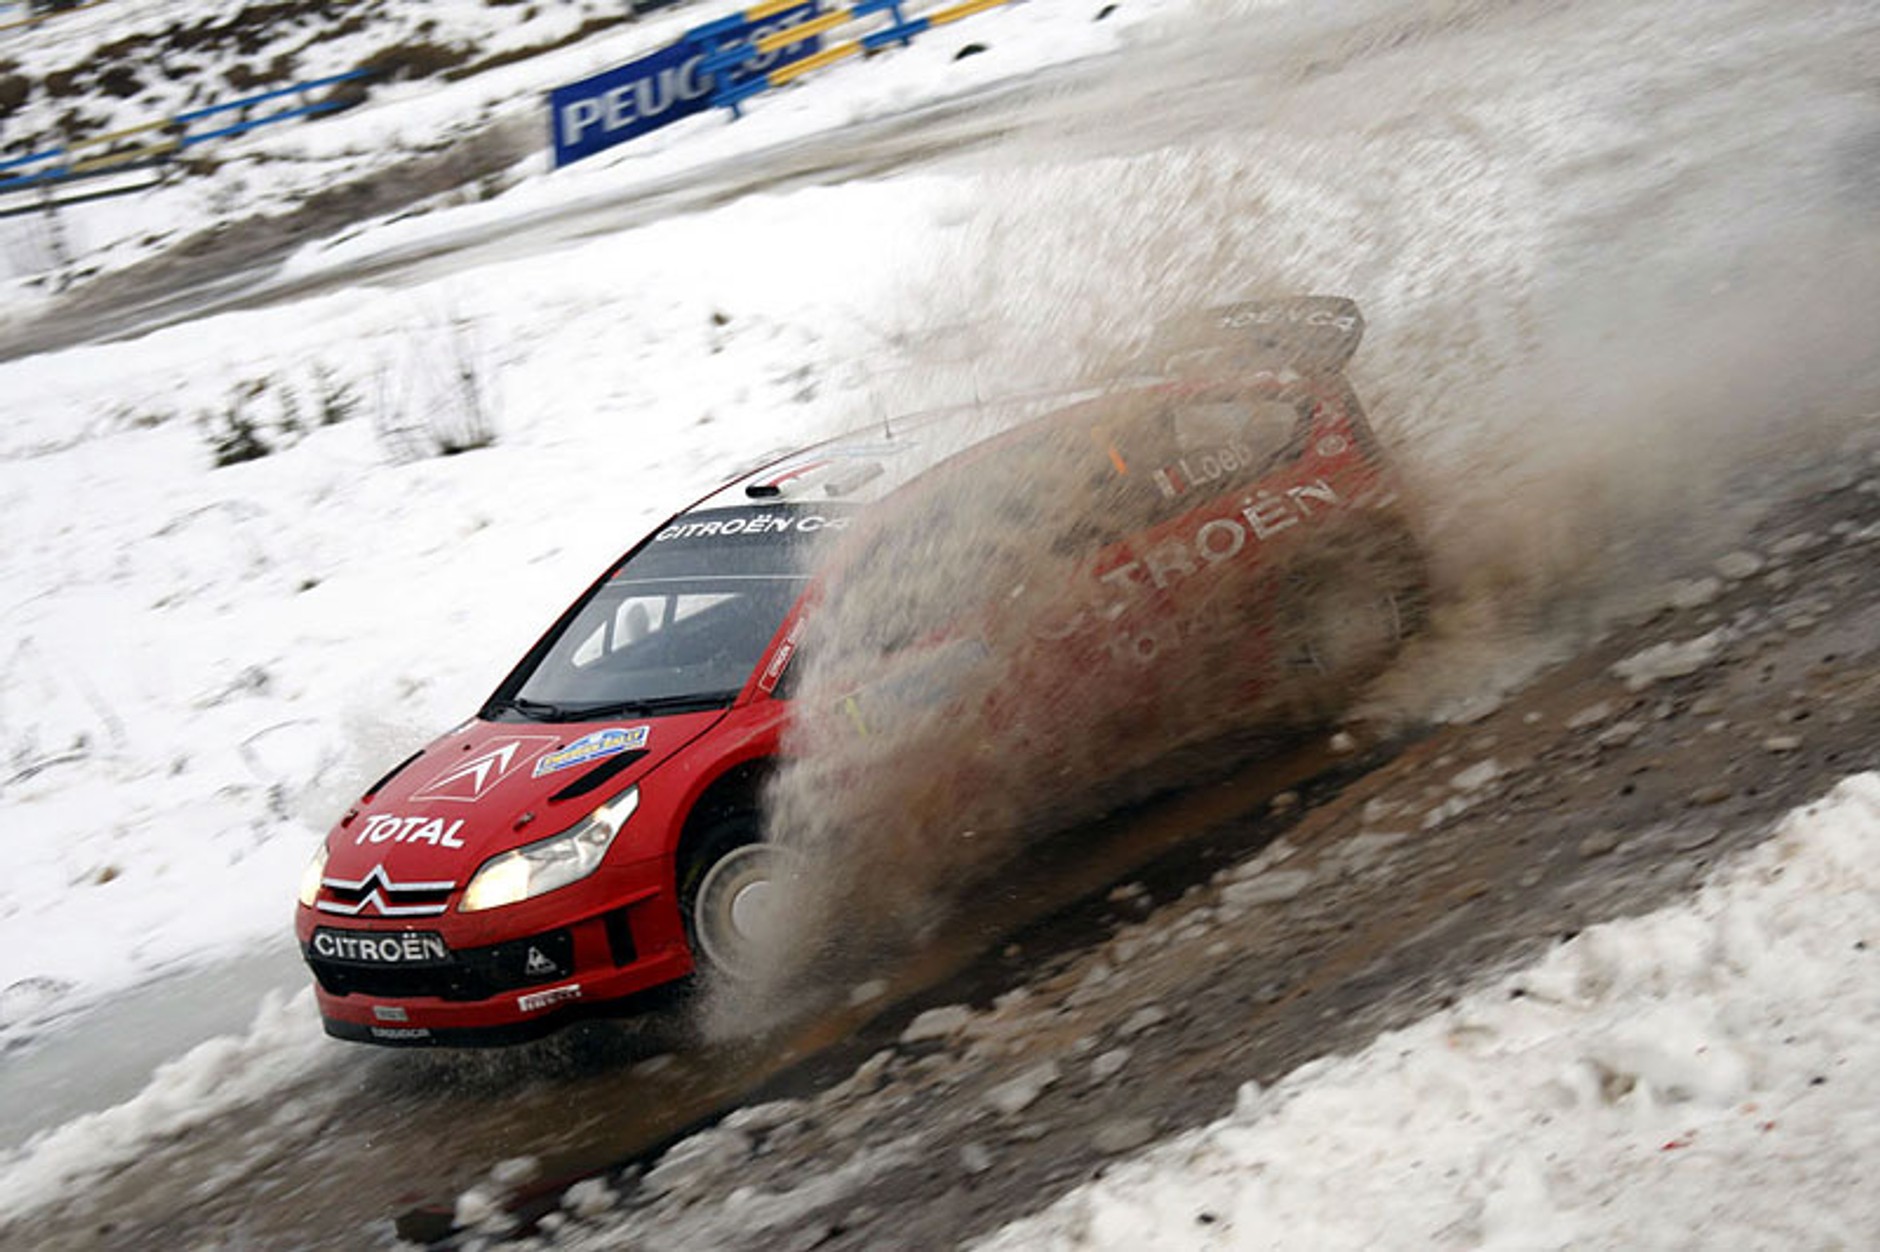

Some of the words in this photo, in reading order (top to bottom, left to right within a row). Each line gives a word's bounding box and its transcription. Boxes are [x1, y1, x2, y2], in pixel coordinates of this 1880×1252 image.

[656, 513, 795, 542] CITROËN
[355, 814, 466, 848] TOTAL
[313, 932, 447, 962] CITROËN
